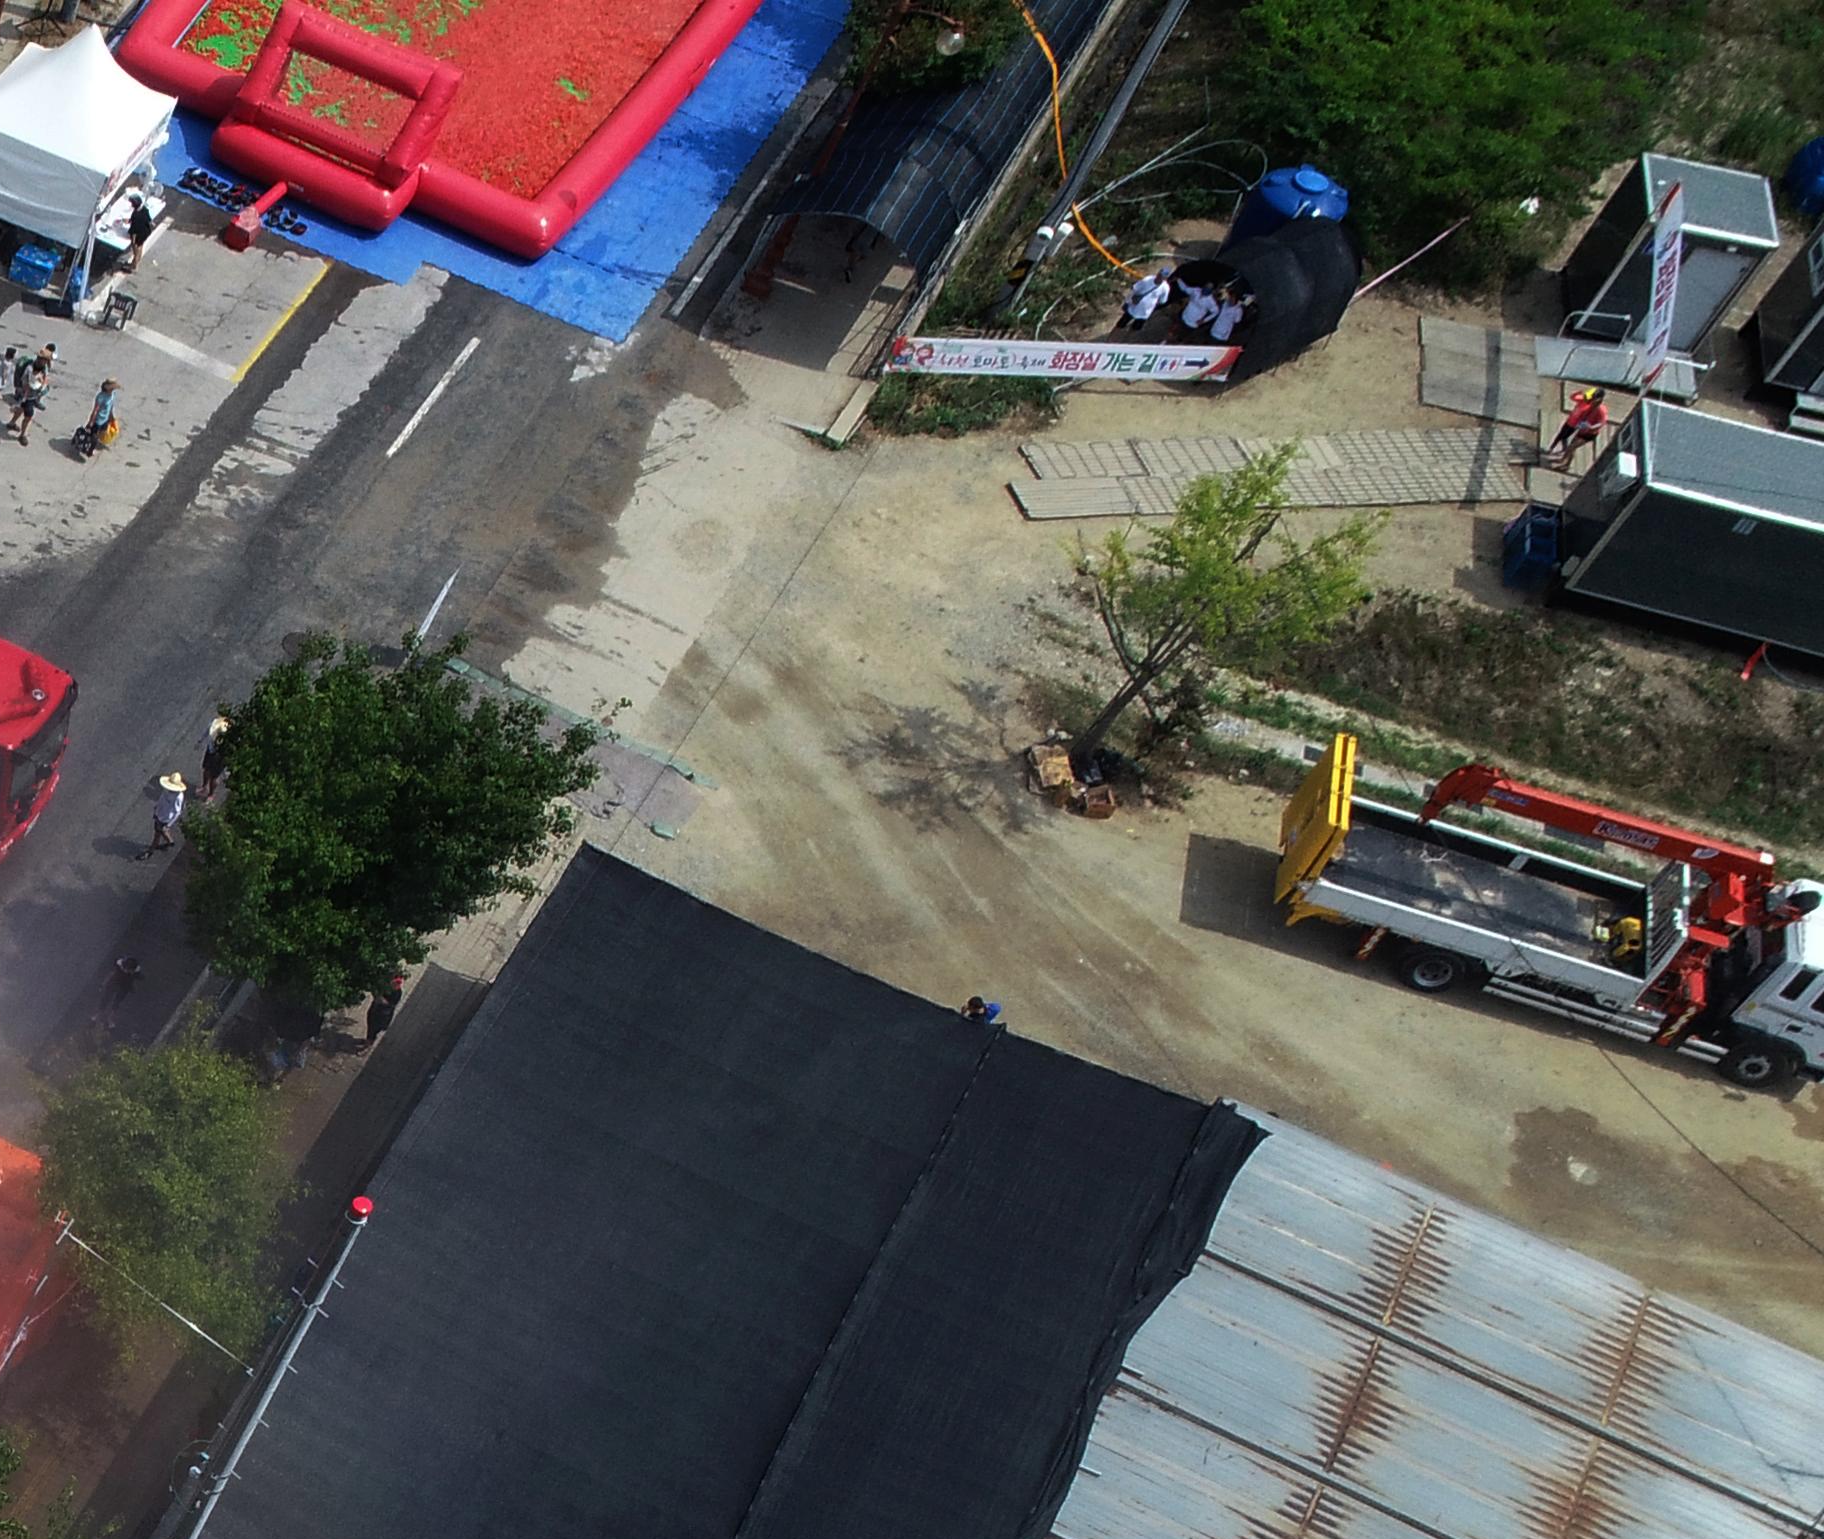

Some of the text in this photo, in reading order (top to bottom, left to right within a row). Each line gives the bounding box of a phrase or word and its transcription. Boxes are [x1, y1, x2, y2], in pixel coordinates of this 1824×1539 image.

[1049, 351, 1100, 371] 화장실
[1102, 352, 1135, 372] 가는
[1137, 353, 1158, 373] 길
